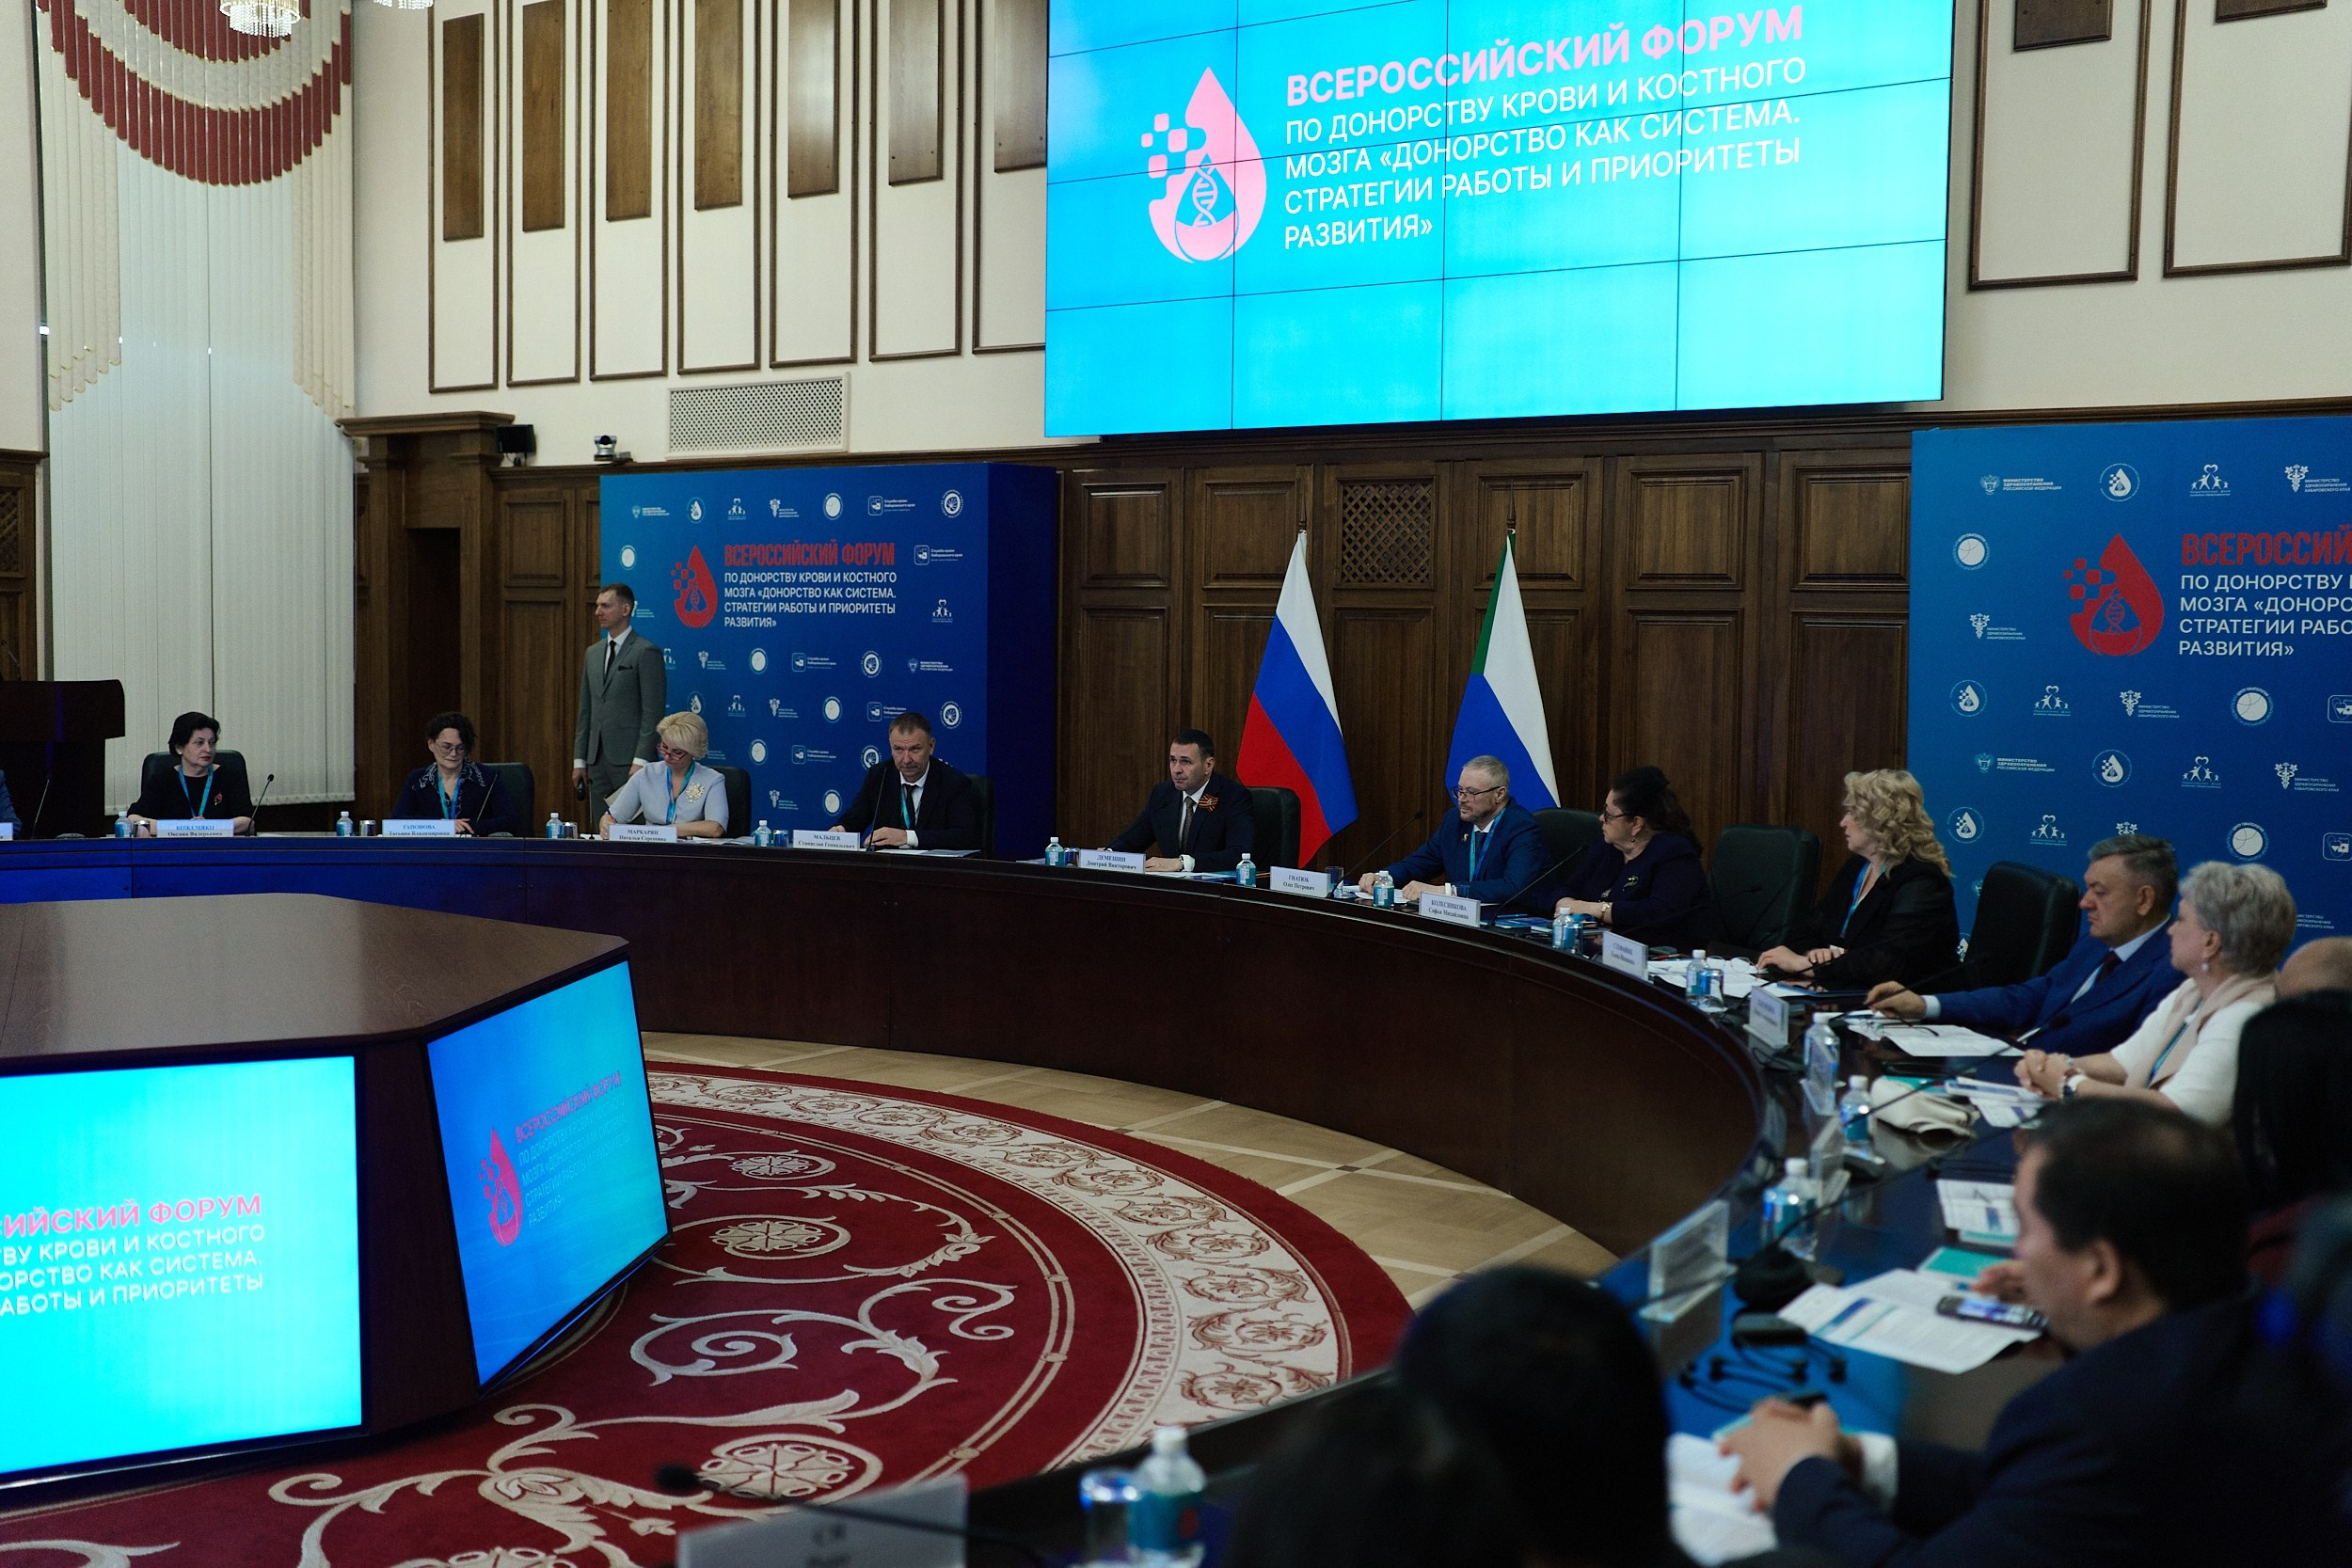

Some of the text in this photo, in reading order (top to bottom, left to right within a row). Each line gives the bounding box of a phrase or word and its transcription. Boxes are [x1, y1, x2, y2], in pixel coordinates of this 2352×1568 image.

[1287, 5, 1803, 106] ВСЕРОССИЙСКИЙ ФОРУМ
[1286, 57, 1805, 144] ПО ДОНОРСТВУ КРОВИ И КОСТНОГО
[1286, 99, 1800, 179] МОЗГА «ДОНОРСТВО КАК СИСТЕМА.
[1285, 137, 1799, 214] СТРАТЕГИИ РАБОТЫ И ПРИОРИТЕТЫ
[1285, 214, 1433, 249] РАЗВИТИЯ»
[724, 539, 895, 566] ВСЕРОССИЙСКИЙ ФОРУМ
[2182, 524, 2352, 565] ВСЕРОССИЙ
[724, 572, 898, 584] ПО ДОНОРСТВУ КРОВИ И КОСТНОГО
[724, 588, 897, 599] МОЗГА «ДОНОРСТВО КАК СИСТЕМА.
[2181, 575, 2209, 590] ПО
[2214, 575, 2344, 593] ДОНОРСТВУ
[724, 602, 896, 614] СТРАТЕГИИ РАБОТЫ И ПРИОРИТЕТЫ
[2180, 596, 2248, 611] МОЗГА
[724, 617, 776, 627] РАЗВИТИЯ»
[2179, 619, 2295, 634] СТРАТЕГИИ
[2179, 641, 2295, 657] РАЗВИТИЯ»
[0, 1195, 261, 1239] ИЙСКИЙ ФОРУМ
[0, 1225, 264, 1266] ВУ КРОВИ И КОСТНОГО
[100, 1259, 142, 1281] КАК
[150, 1250, 262, 1275] СИСТЕМА.
[89, 1289, 104, 1307] И
[113, 1274, 263, 1305] ПРИОРИТЕТЫ
